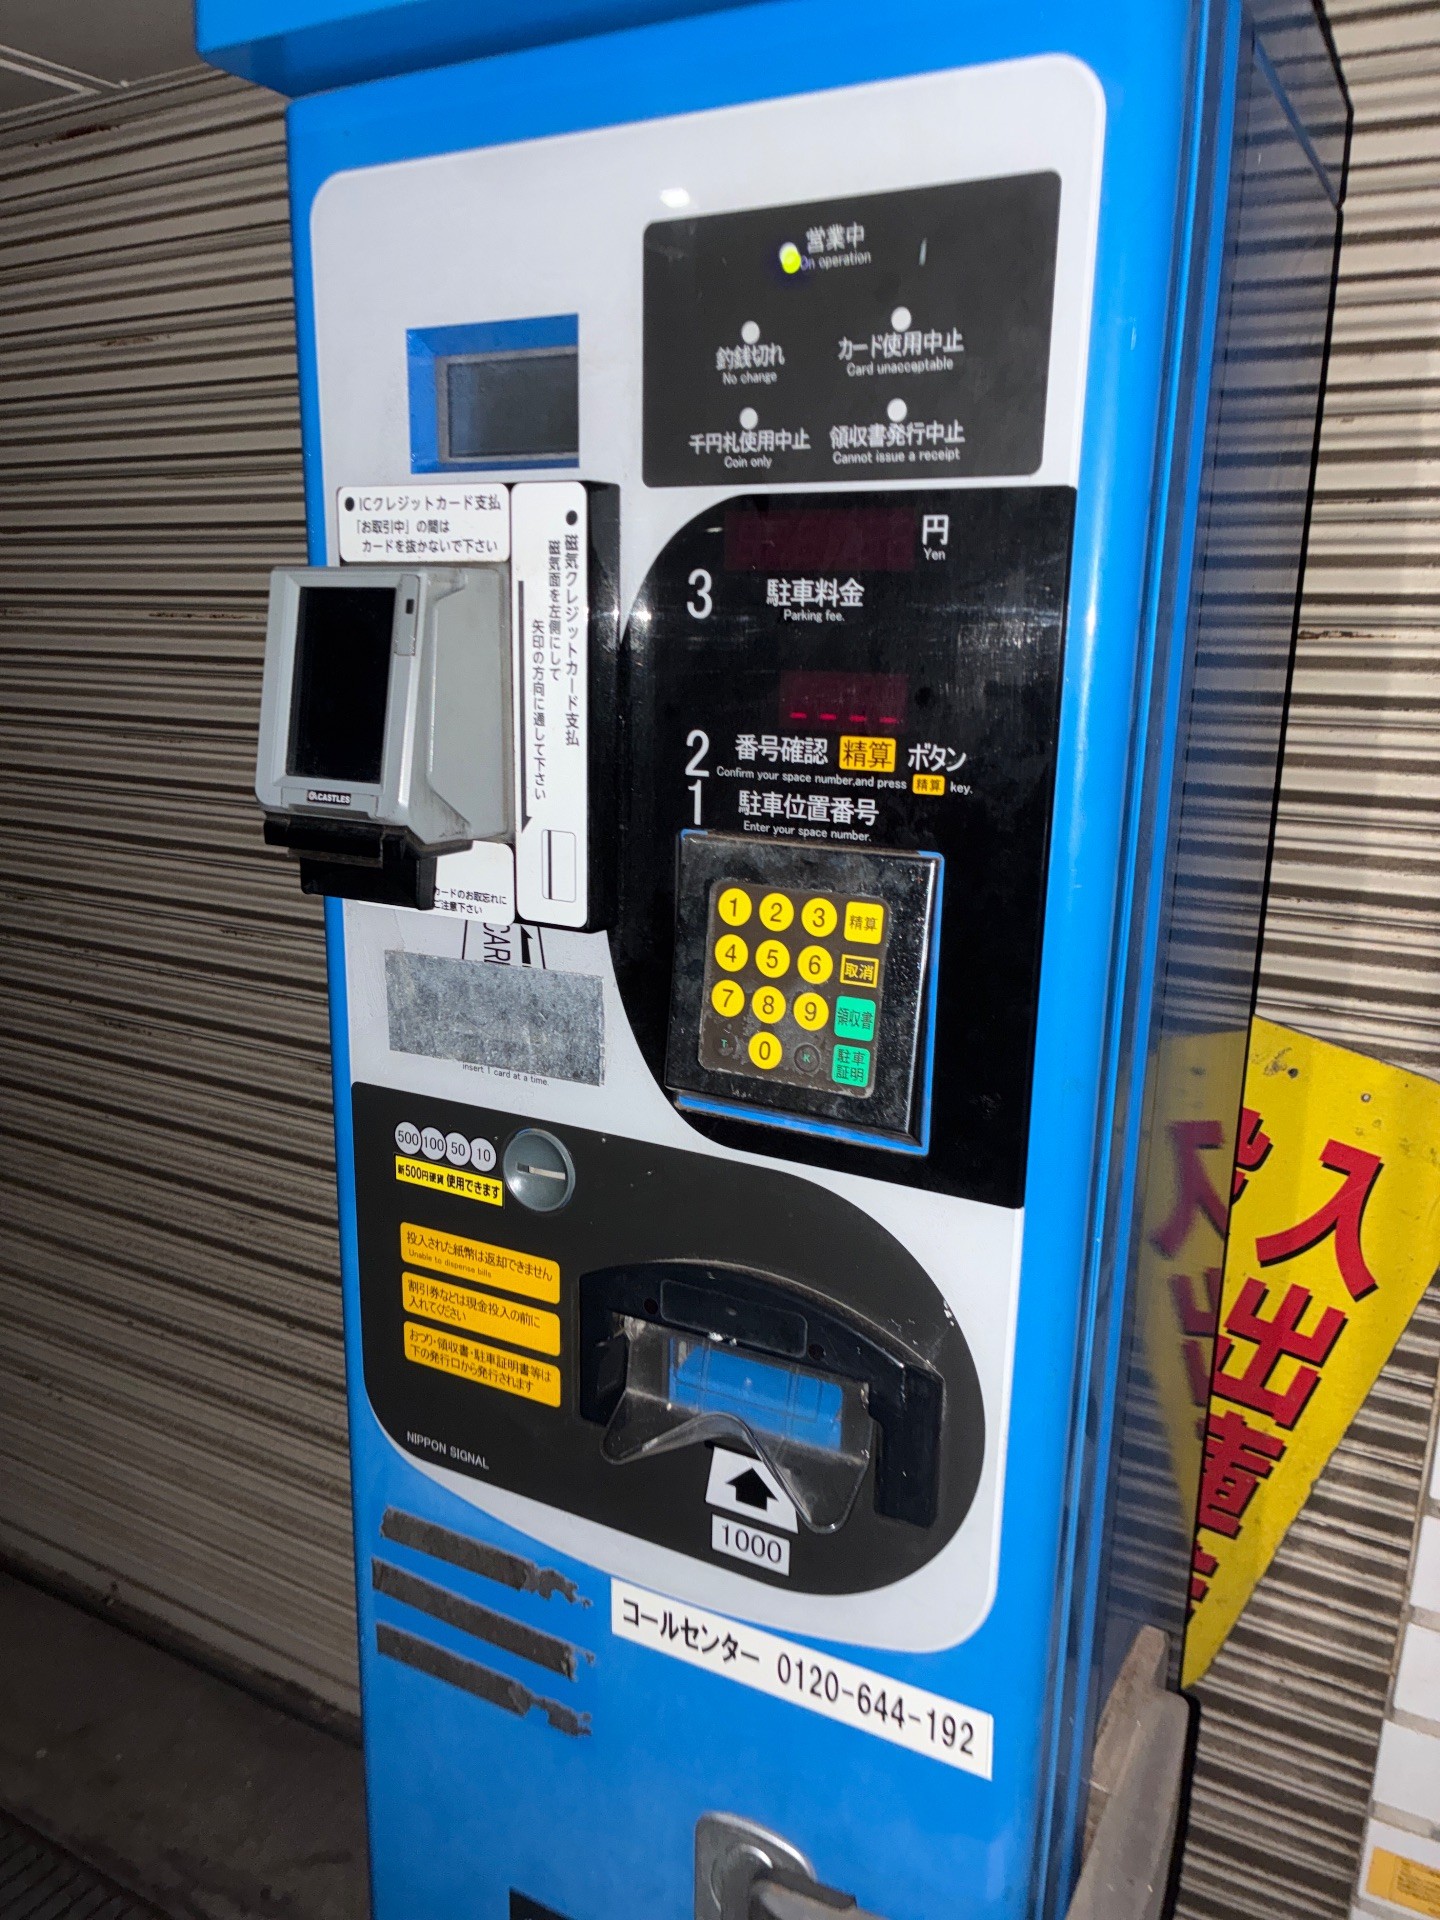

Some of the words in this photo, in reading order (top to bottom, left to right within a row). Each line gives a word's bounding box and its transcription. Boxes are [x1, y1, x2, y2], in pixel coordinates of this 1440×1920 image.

[806, 221, 865, 253] 営業中
[801, 255, 815, 270] On
[819, 250, 872, 269] operation
[838, 327, 964, 361] カード使用中止
[722, 371, 738, 385] No
[740, 370, 778, 385] change
[846, 361, 874, 377] Card
[877, 356, 954, 375] unacceptable
[688, 427, 812, 455] 千円札使用中止
[829, 418, 966, 450] 領収書発行中止
[723, 455, 748, 469] Coin
[750, 454, 773, 469] only
[832, 450, 873, 465] Cannot
[876, 450, 905, 464] issue
[908, 453, 916, 463] a
[919, 447, 960, 464] receipt
[358, 494, 502, 512] ICクレジットカード支払
[922, 514, 949, 546] 円
[361, 538, 498, 553] カードを抜かないで下さい
[923, 547, 946, 561] Yen
[686, 568, 713, 619] 3
[766, 577, 865, 609] 駐車料金
[548, 540, 562, 681] 磁気面を左側にして
[783, 609, 823, 623] Parking
[825, 608, 846, 622] fee.
[565, 534, 580, 747] 磁気クレジットカード支払
[532, 619, 547, 800] 矢印の方向に通して下さい
[684, 729, 711, 778] 2
[735, 734, 829, 764] 番号確認
[842, 738, 894, 769] 精算
[908, 743, 968, 773] ボタン
[716, 766, 755, 779] Confirm
[757, 769, 779, 782] your
[782, 771, 812, 784] space
[877, 778, 908, 790] press
[915, 778, 942, 791] 精算
[950, 780, 974, 795] key.
[317, 793, 351, 804] CASTLES
[687, 779, 702, 825] 1
[738, 790, 880, 827] 駐車位置番号
[743, 821, 769, 833] Enter
[772, 823, 795, 837] your
[797, 826, 828, 839] space
[830, 828, 872, 842] number.
[730, 897, 738, 917] 1
[770, 902, 783, 922] 2
[812, 907, 826, 928] 3
[849, 915, 878, 931] 精算
[483, 922, 511, 966] CAR
[724, 944, 737, 963] 4
[765, 949, 778, 968] 5
[808, 954, 822, 975] 6
[844, 962, 875, 982] 取消
[721, 988, 734, 1008] 7
[762, 994, 775, 1015] 8
[803, 1000, 817, 1021] 9
[838, 1007, 873, 1030] 領収書
[758, 1040, 771, 1060] 0
[493, 1069, 511, 1079] card
[513, 1072, 521, 1081] at
[530, 1074, 550, 1086] time.
[398, 1130, 419, 1146] 500
[424, 1135, 445, 1152] 100
[451, 1141, 466, 1157] 50
[477, 1147, 491, 1162] 10
[397, 1164, 445, 1185] 新500円硬貨
[446, 1172, 500, 1199] 使用できます
[406, 1230, 553, 1282] 投入された紙幣は返却できません
[408, 1249, 433, 1262] Unable
[435, 1256, 443, 1265] to
[444, 1258, 476, 1275] dispense
[477, 1267, 492, 1278] bills
[408, 1279, 541, 1328] 割引券などは現金投入の前に
[409, 1296, 467, 1322] 入れてください
[409, 1328, 552, 1383] おつり・領収書・駐車証明書等は
[410, 1344, 534, 1393] 下の発行口から発行されます
[406, 1430, 447, 1455] NIPPON
[449, 1445, 490, 1471] SIGNAL
[720, 1523, 783, 1565] 1000
[623, 1597, 761, 1664] コールセンター
[776, 1652, 975, 1756] 0120-644-192
